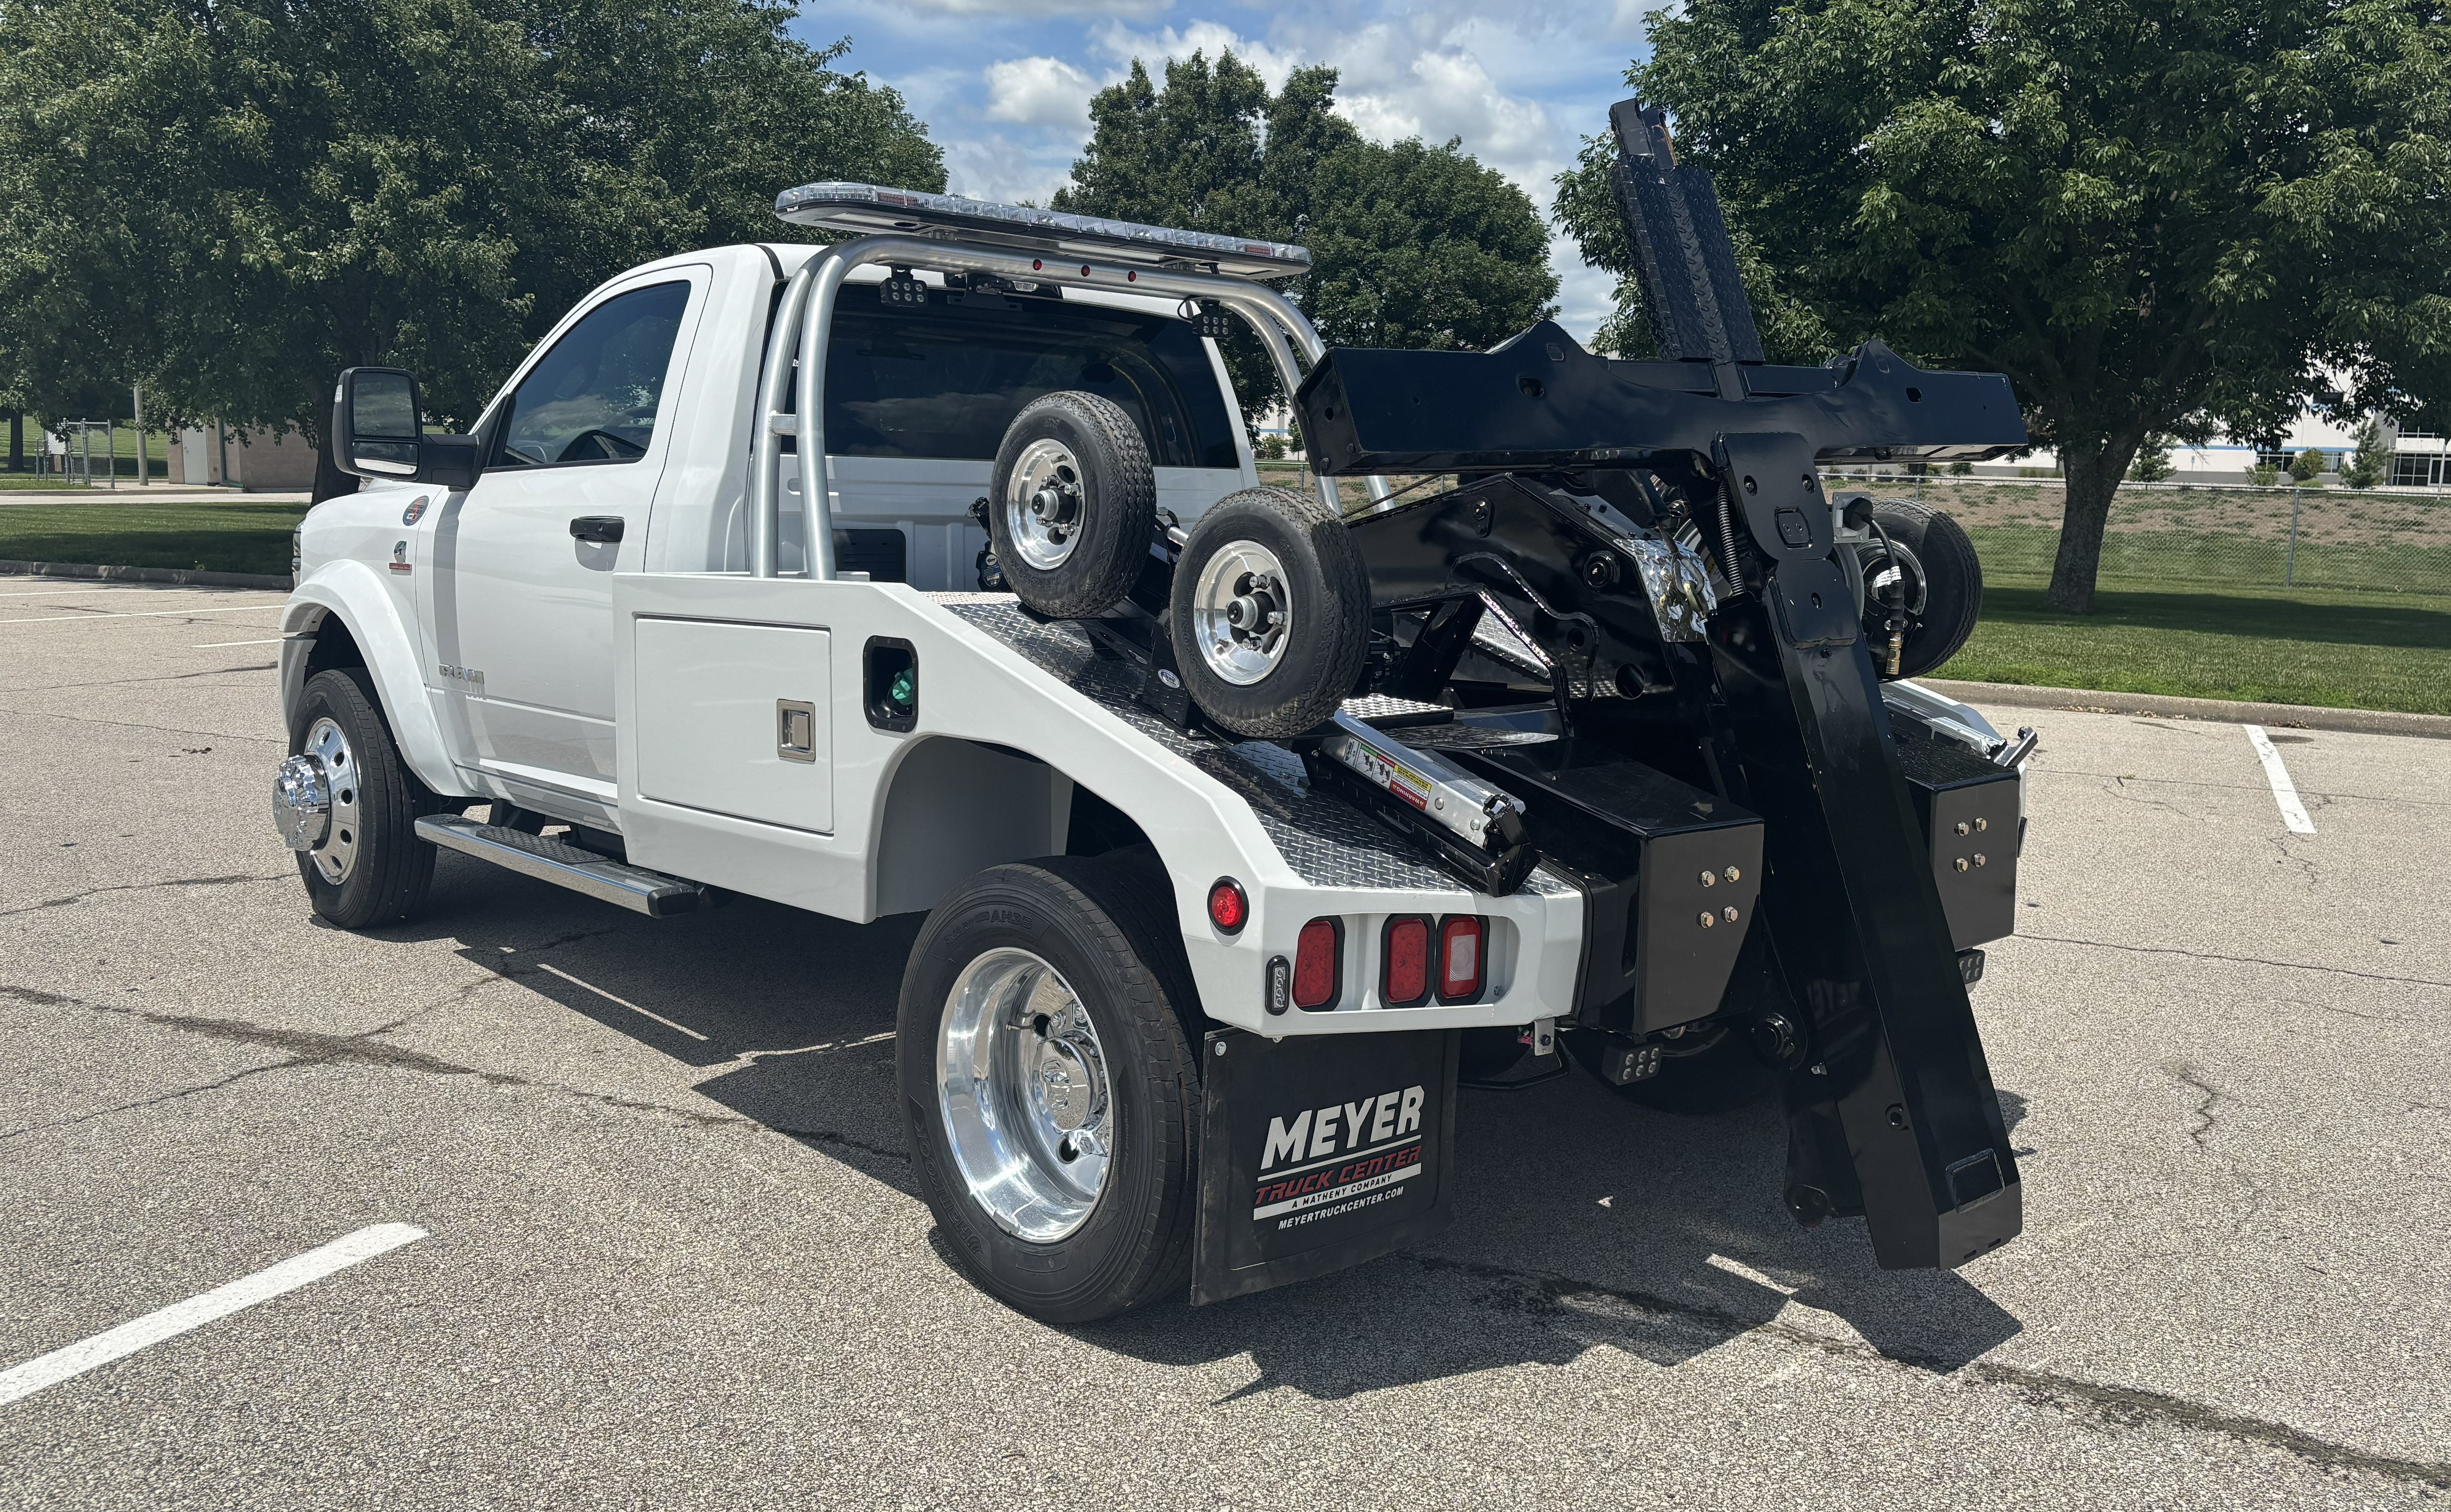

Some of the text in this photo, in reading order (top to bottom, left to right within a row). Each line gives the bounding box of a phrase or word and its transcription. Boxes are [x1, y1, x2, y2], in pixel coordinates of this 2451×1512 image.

[439, 663, 484, 684] RAM
[1396, 787, 1420, 804] WARNING
[991, 910, 1032, 929] AH35
[1260, 1085, 1425, 1170] MEYER
[1255, 1145, 1421, 1205] TRUCK CENTER
[1292, 1174, 1392, 1208] A MATHENY COMPANY
[1278, 1186, 1403, 1230] MEYERTRUCKCENTER.COM
